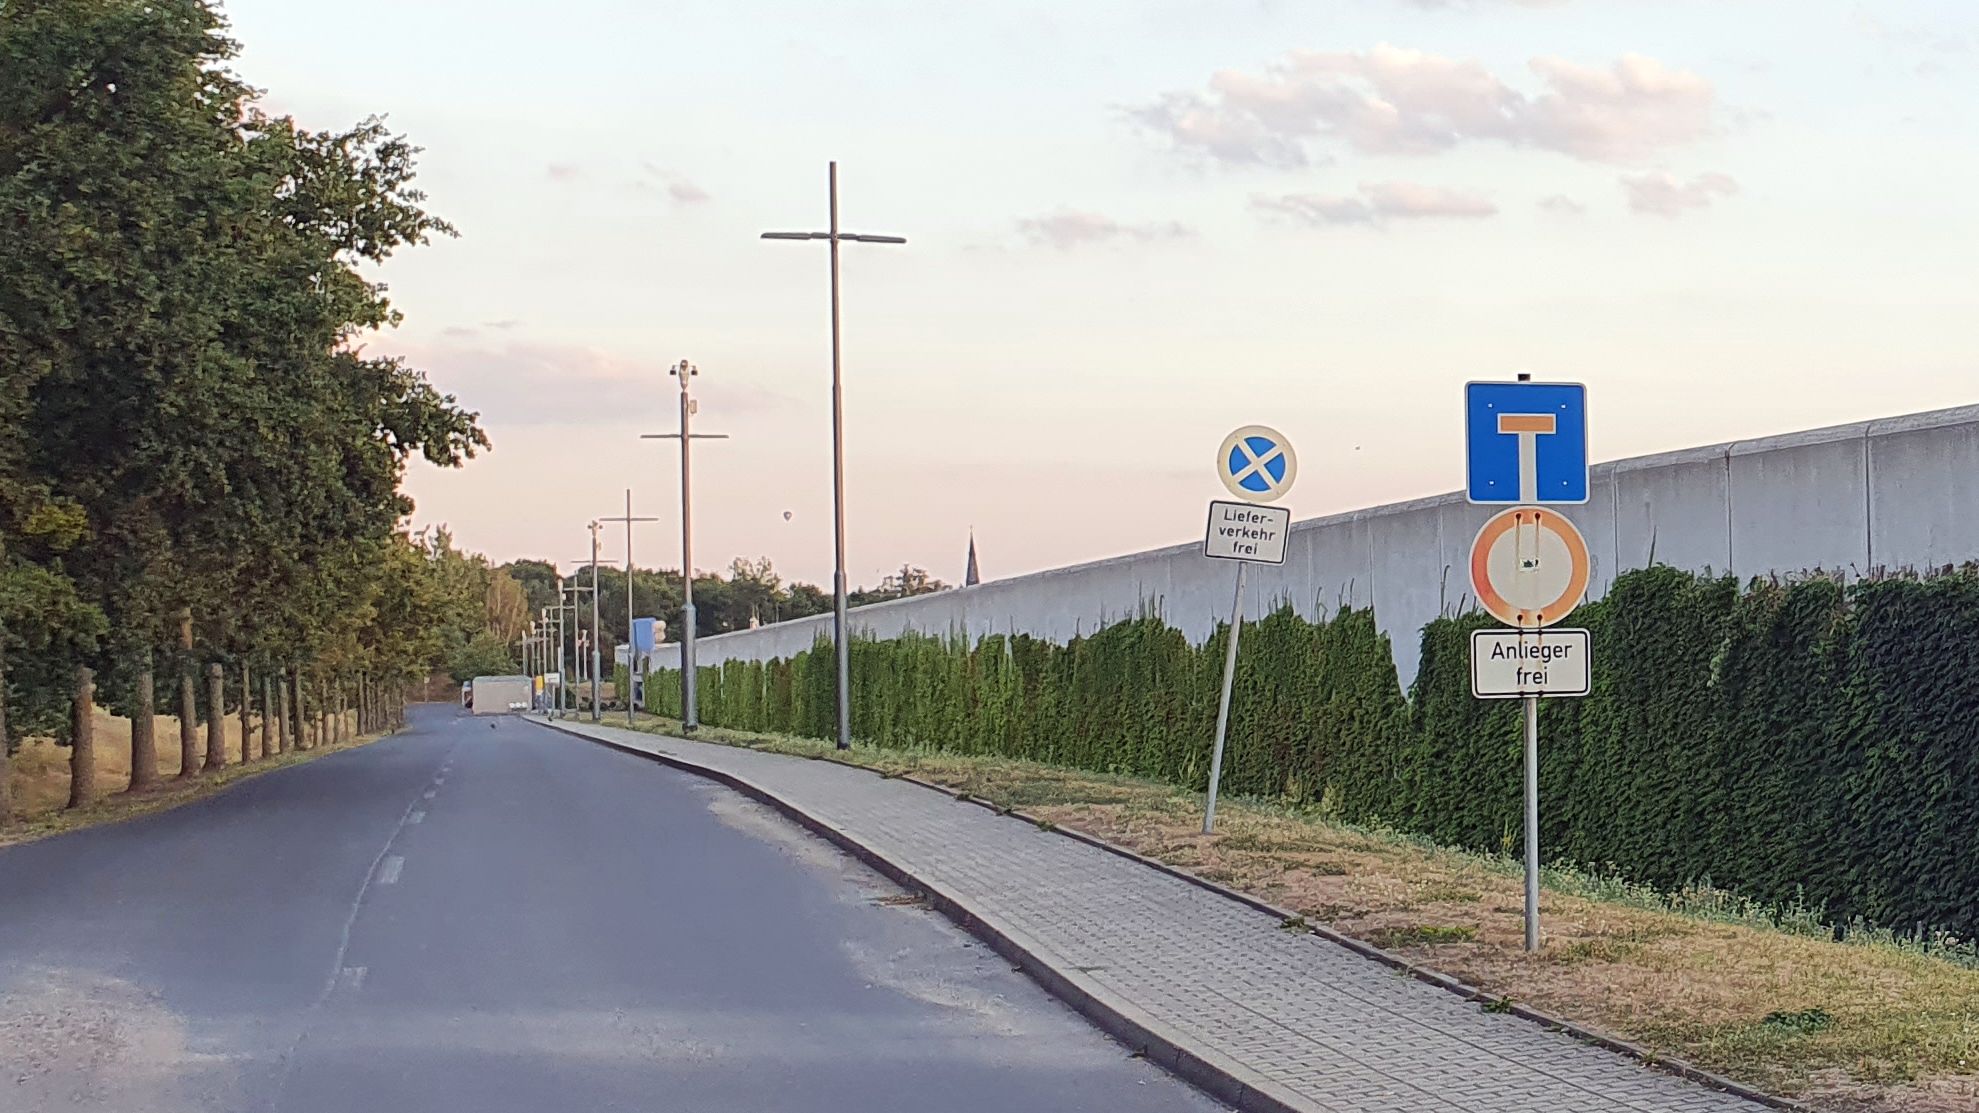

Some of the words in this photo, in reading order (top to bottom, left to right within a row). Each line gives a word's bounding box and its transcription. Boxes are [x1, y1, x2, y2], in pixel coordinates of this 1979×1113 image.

[1224, 508, 1273, 524] Liefer-
[1219, 526, 1276, 541] verkehr
[1233, 541, 1258, 555] frei
[1491, 641, 1572, 663] Anlieger
[1517, 666, 1547, 685] frei
